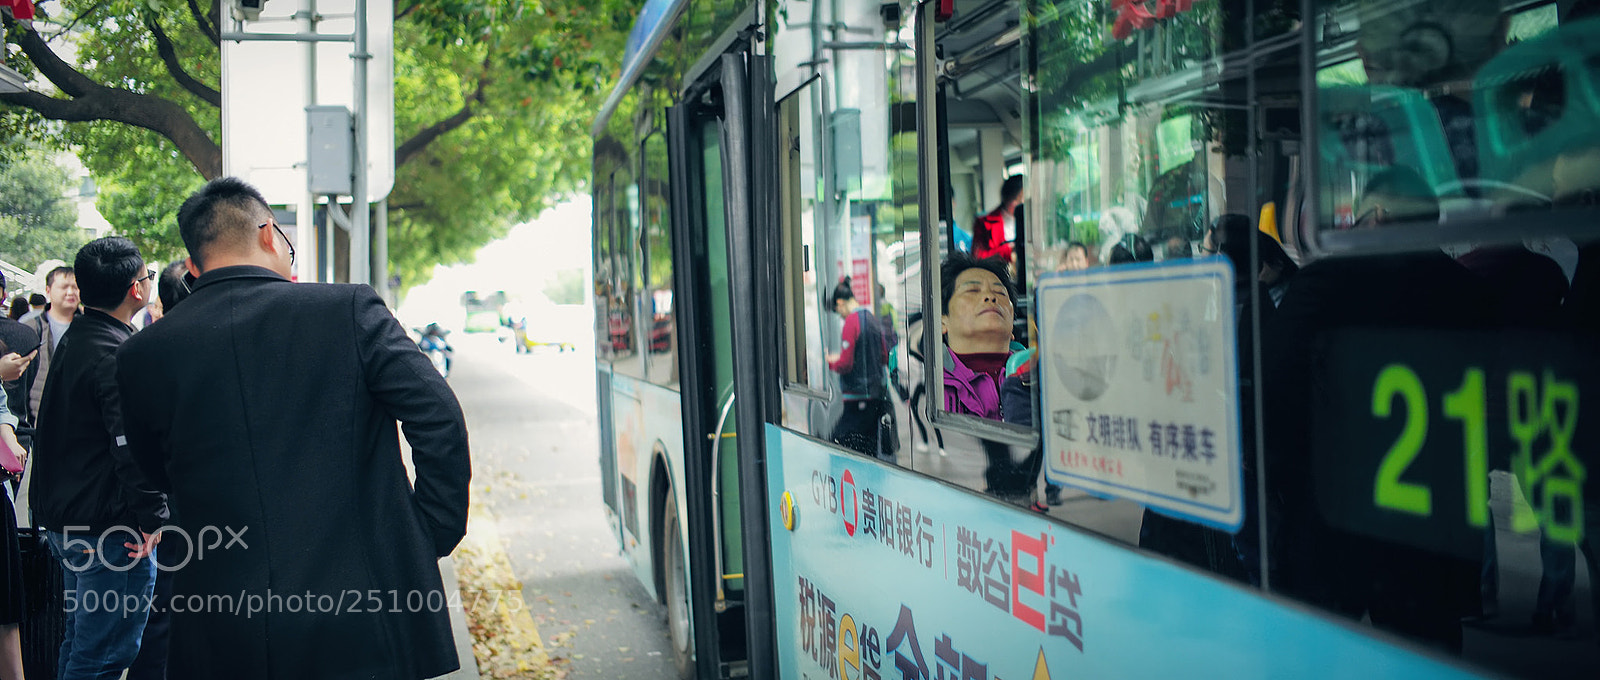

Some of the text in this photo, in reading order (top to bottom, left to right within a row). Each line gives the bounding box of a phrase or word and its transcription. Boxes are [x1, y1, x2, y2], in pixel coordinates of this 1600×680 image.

[1086, 412, 1143, 452] 文明排队
[1147, 419, 1219, 466] 有序乘车
[811, 470, 838, 515] GYB
[861, 488, 935, 569] 贵阳银行
